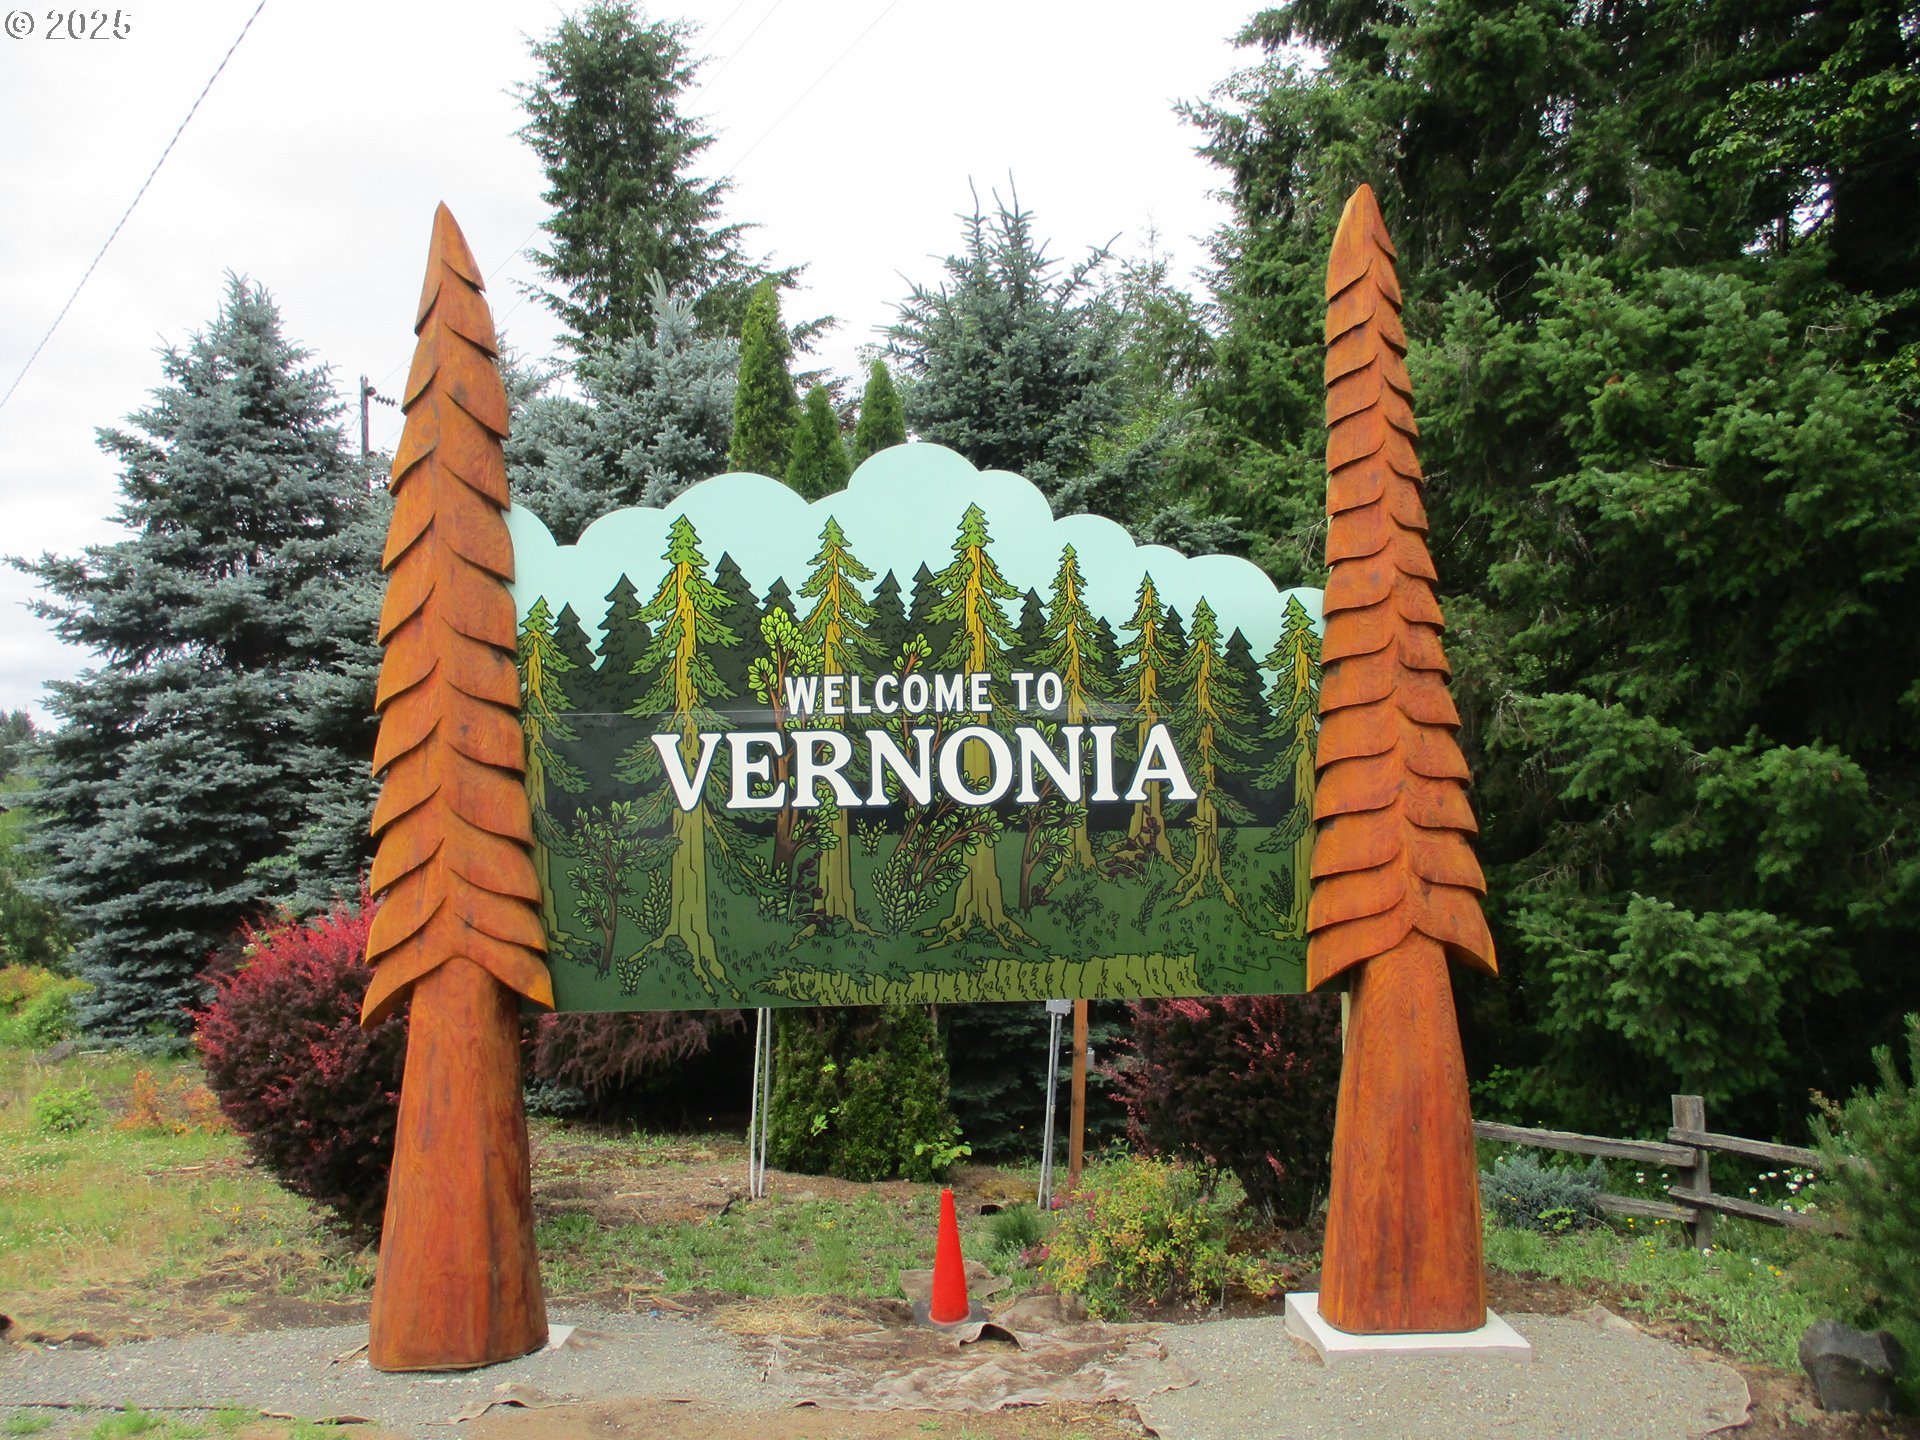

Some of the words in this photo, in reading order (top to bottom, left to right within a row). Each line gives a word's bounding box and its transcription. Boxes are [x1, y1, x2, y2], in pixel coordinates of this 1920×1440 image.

[784, 673, 992, 715] WELCOME
[1011, 671, 1063, 711] TO
[651, 724, 1197, 811] VERNONIA
